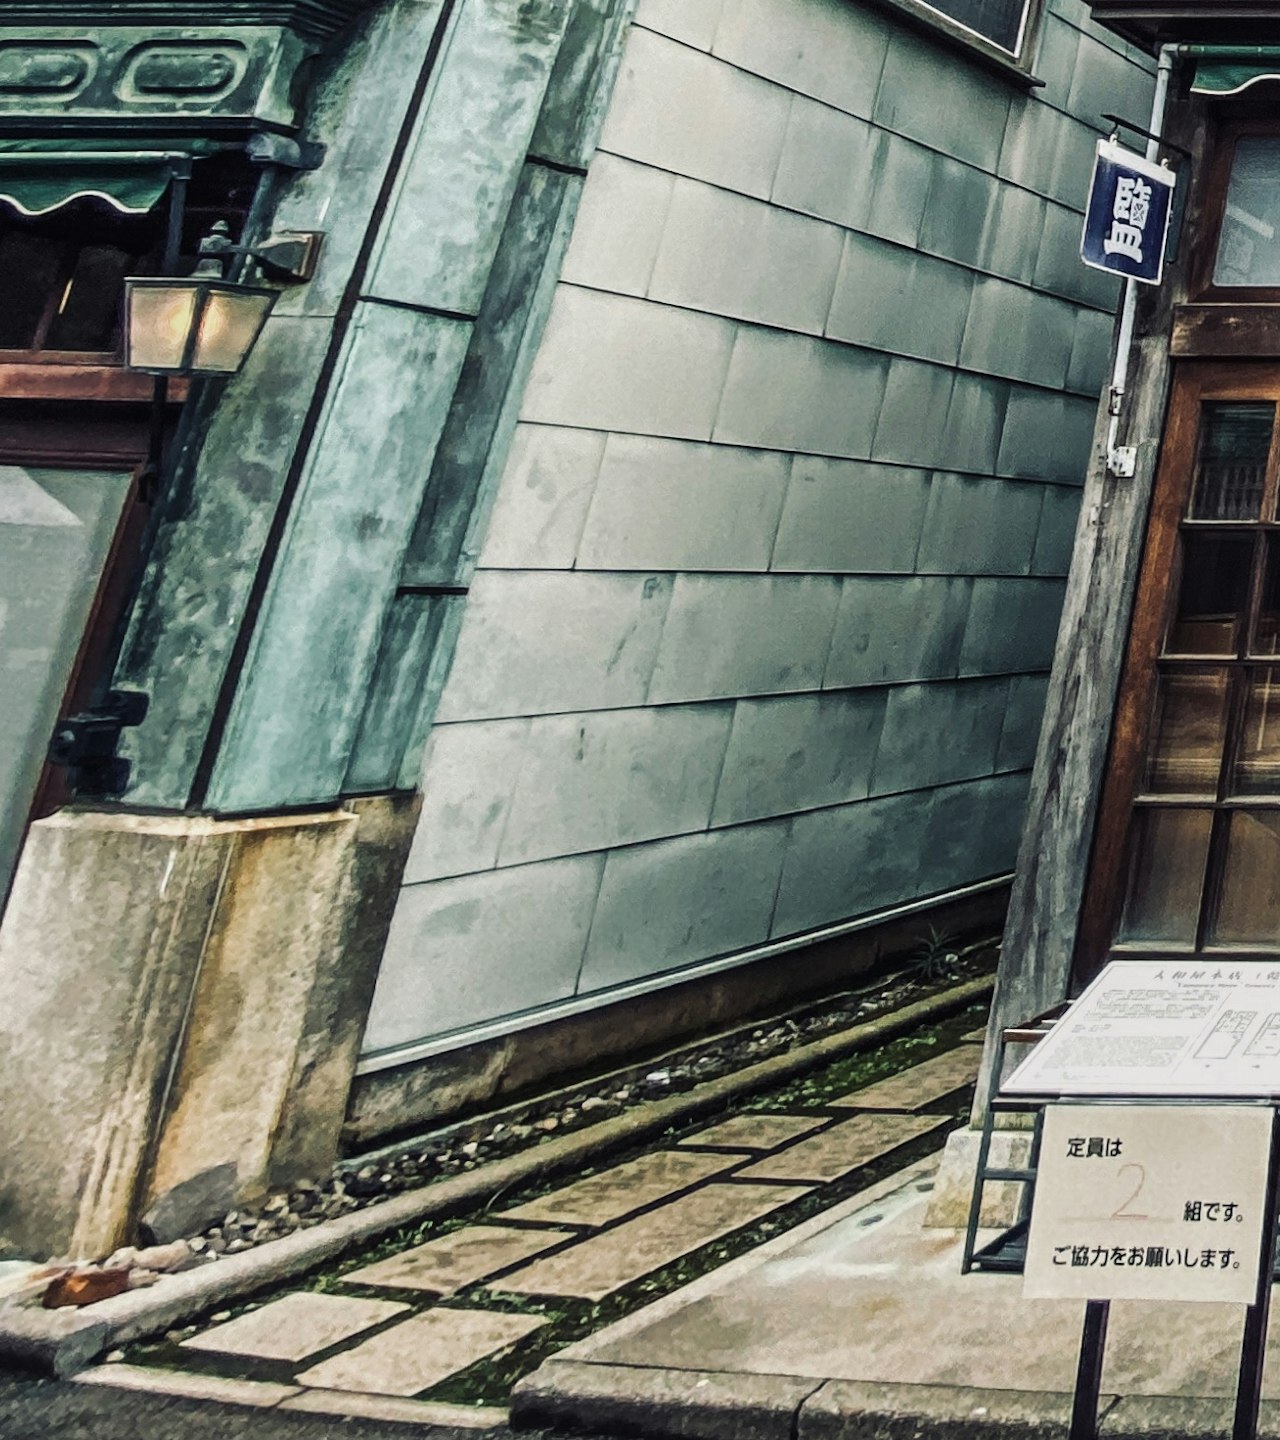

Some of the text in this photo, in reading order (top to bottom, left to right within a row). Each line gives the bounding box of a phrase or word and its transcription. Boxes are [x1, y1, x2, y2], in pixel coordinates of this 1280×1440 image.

[1066, 1137, 1122, 1158] 定員は
[1110, 1163, 1243, 1223] 2 組です。
[1052, 1246, 1241, 1269] ご協力をお願いします。
